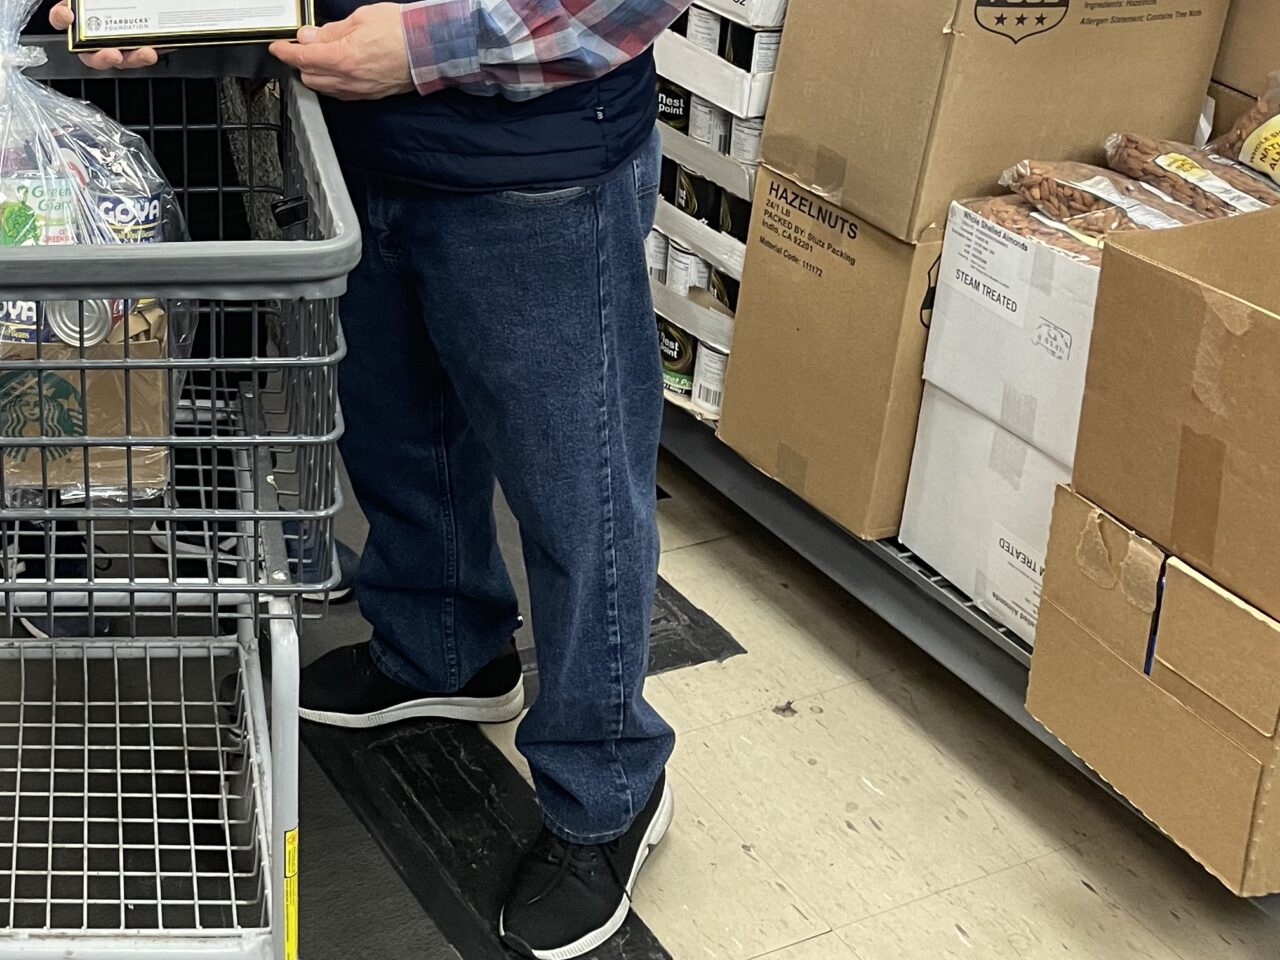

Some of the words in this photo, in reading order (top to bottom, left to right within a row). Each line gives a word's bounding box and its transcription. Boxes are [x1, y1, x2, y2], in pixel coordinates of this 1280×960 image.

[104, 17, 148, 26] STARBUCKS
[104, 24, 149, 32] FOUNDATION
[658, 92, 685, 108] nest
[658, 103, 684, 116] point
[31, 185, 71, 199] Green
[98, 197, 161, 224] GOYA
[768, 180, 859, 240] HAZELNUTS
[781, 206, 792, 218] LB
[763, 208, 793, 230] PACKED
[793, 224, 806, 238] BY:
[826, 243, 856, 267] Packing
[781, 229, 793, 242] CA
[962, 209, 981, 227] Whole
[980, 218, 1002, 239] Shelled
[1002, 231, 1028, 252] Almonds
[955, 268, 981, 292] STEAM
[981, 283, 1018, 314] TREATED
[660, 331, 680, 352] nest
[998, 537, 1037, 574] TREATED
